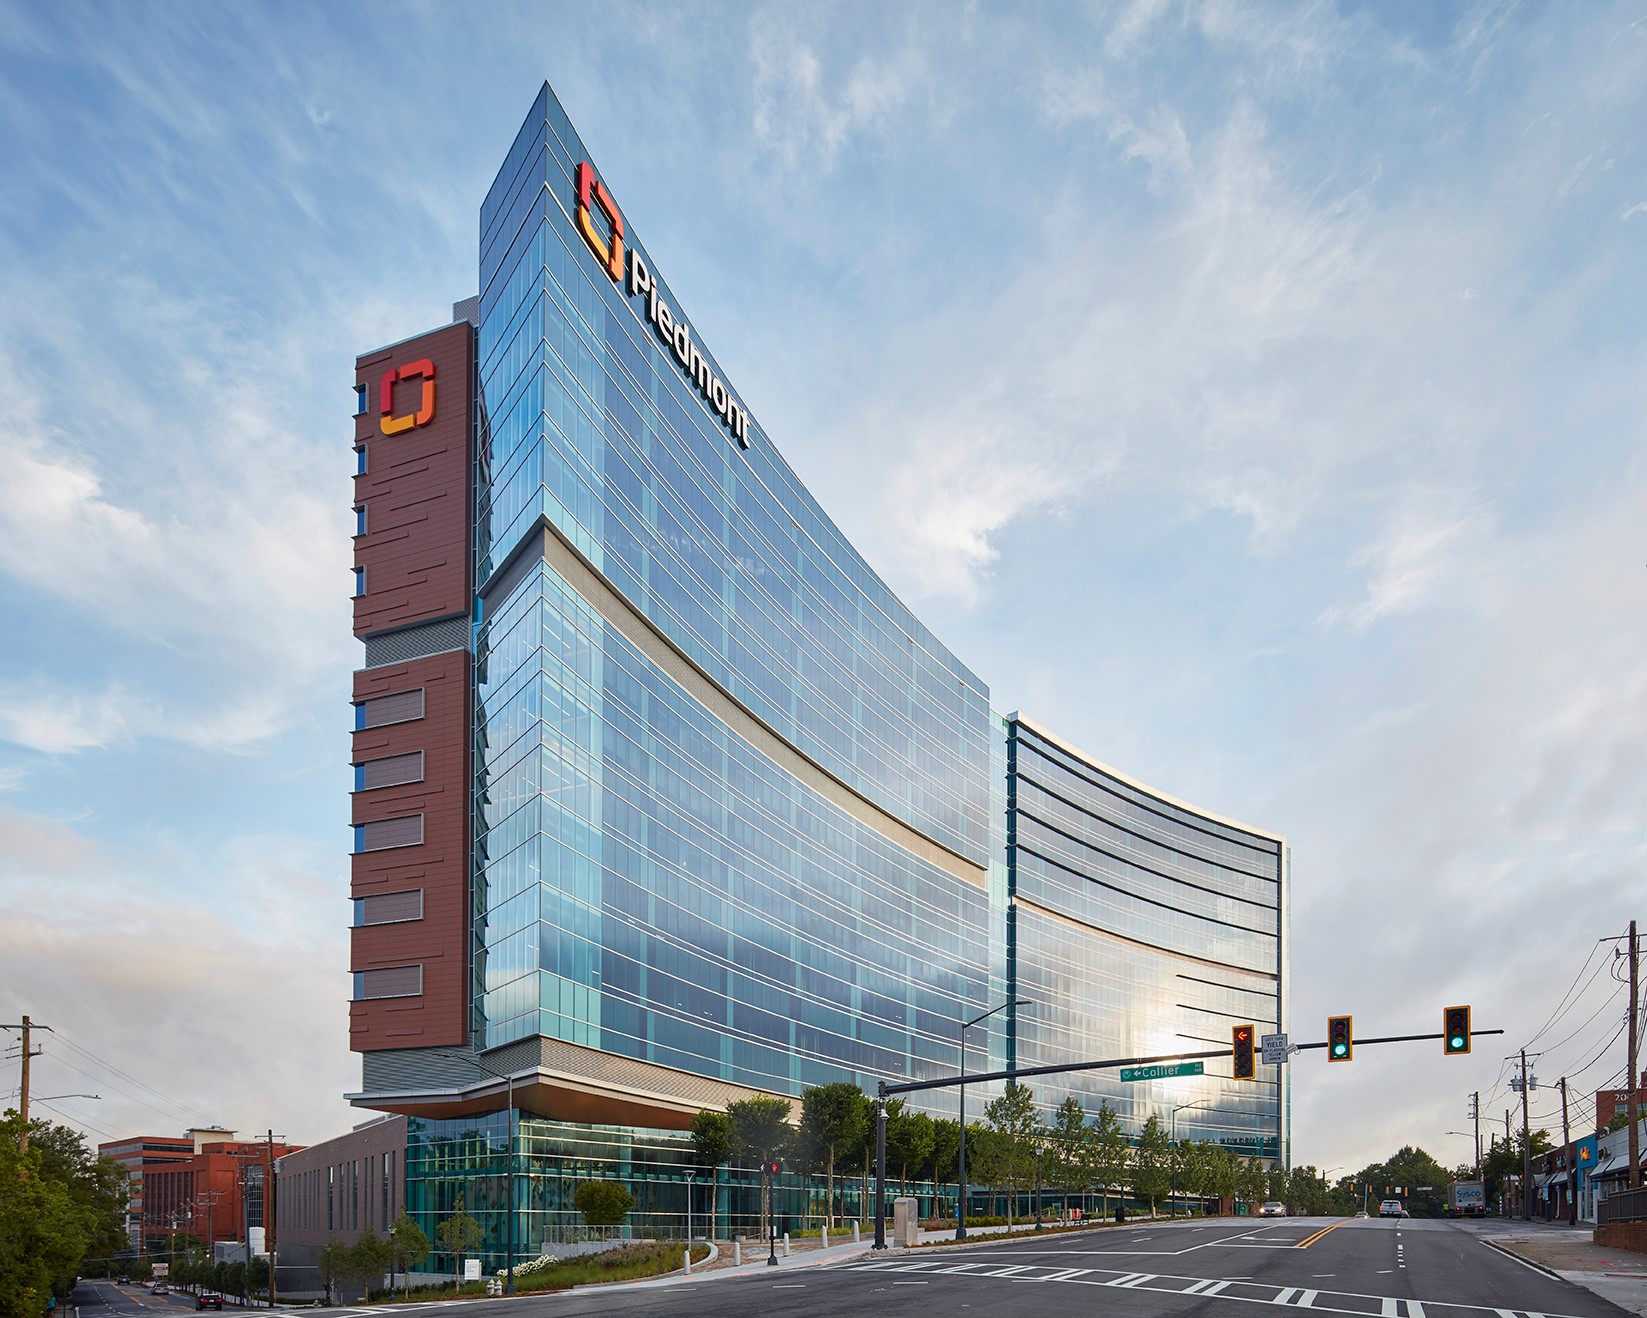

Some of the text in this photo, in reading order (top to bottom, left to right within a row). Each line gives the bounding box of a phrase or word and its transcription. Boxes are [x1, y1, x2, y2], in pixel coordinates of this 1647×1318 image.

[630, 247, 750, 449] Piedmont
[1142, 1066, 1179, 1078] Collier
[1456, 1190, 1482, 1198] Sysco
